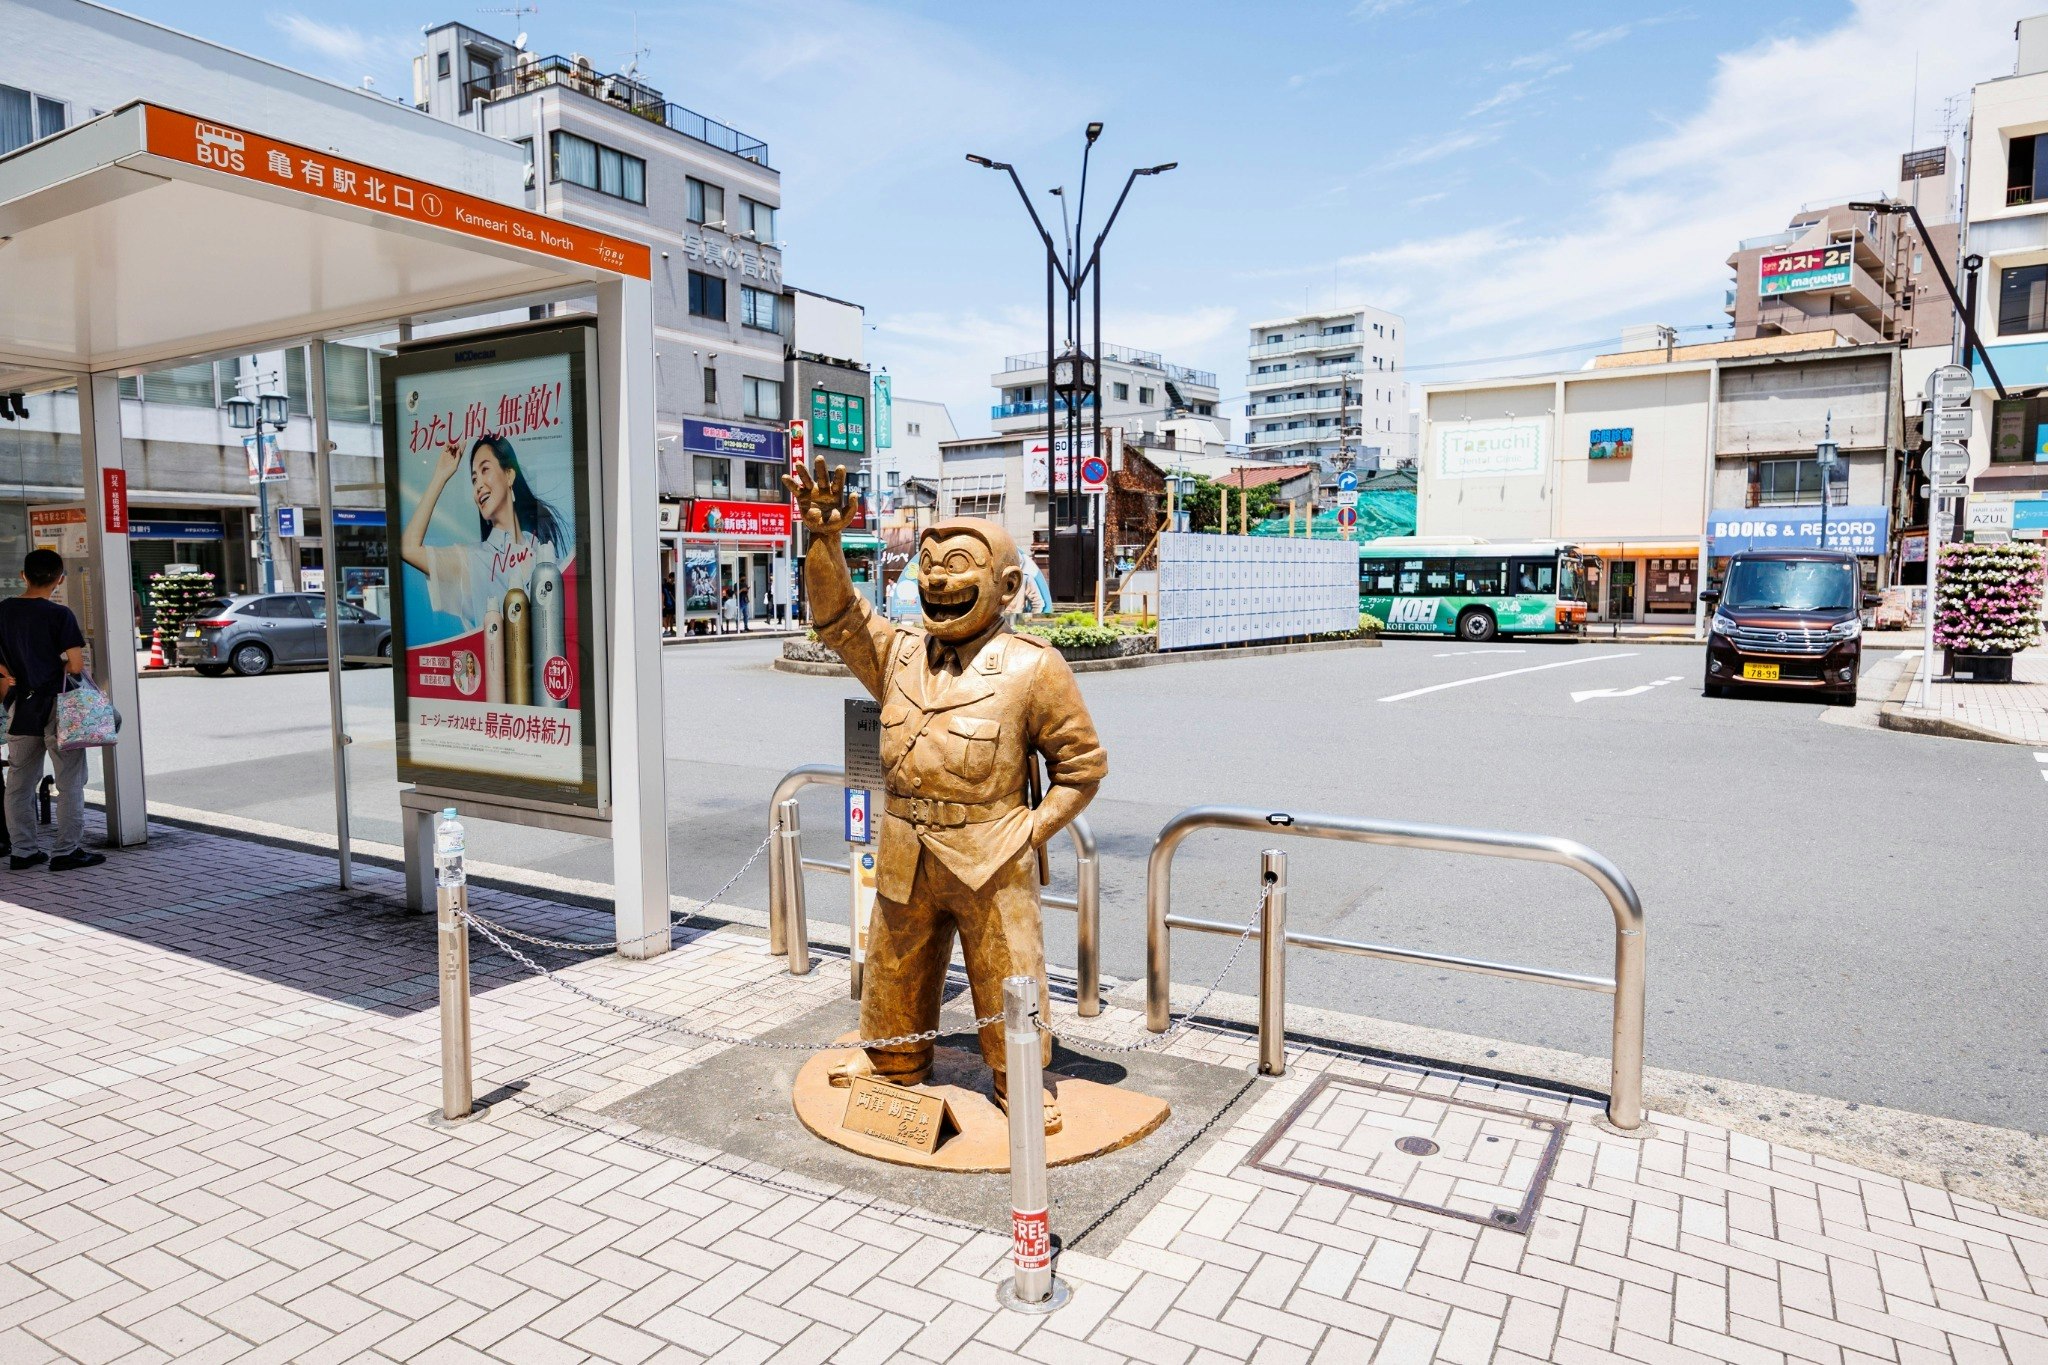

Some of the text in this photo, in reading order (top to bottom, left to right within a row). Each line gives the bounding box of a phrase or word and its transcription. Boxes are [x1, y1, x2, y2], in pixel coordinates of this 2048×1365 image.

[197, 143, 246, 172] BUS
[266, 149, 415, 211] 亀有駅北口
[455, 206, 574, 251] Kameari Sta. North
[599, 246, 625, 260] TOBU
[683, 231, 779, 284] 写真の高沢
[1778, 250, 1850, 272] ガスト 2F
[1791, 272, 1845, 287] maruetsu
[1451, 433, 1529, 453] Taguchi
[1459, 457, 1489, 465] Dental
[1973, 515, 2006, 523] AZUL
[1801, 522, 1875, 536] RECORD
[1388, 597, 1440, 623] KOEI
[1497, 601, 1509, 612] 3A
[1386, 623, 1405, 631] KOEI
[1751, 670, 1777, 678] 78-99
[857, 1091, 885, 1112] 両津
[1013, 1220, 1045, 1240] FREE
[1014, 1239, 1046, 1256] Wi-Fi
